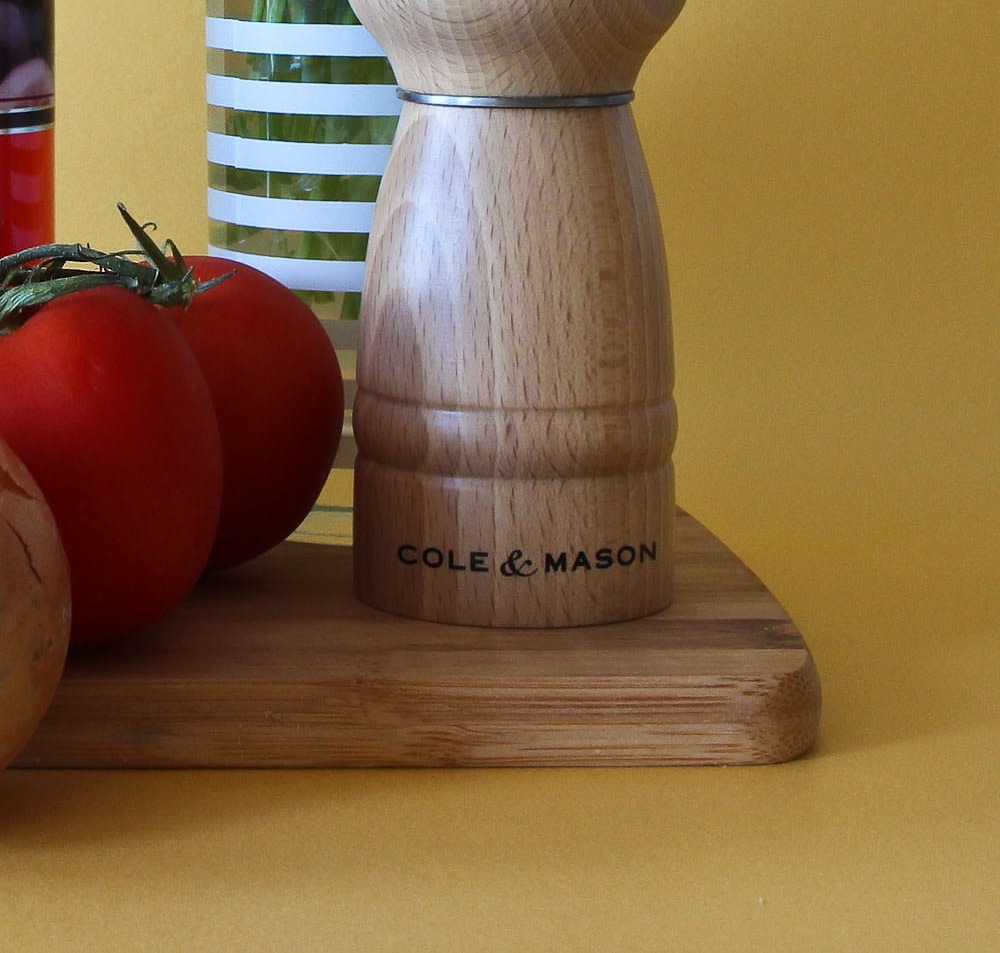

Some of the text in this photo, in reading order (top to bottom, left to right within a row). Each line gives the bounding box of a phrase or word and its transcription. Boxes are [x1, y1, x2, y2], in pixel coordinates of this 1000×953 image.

[397, 541, 657, 577] COLE & MASON
